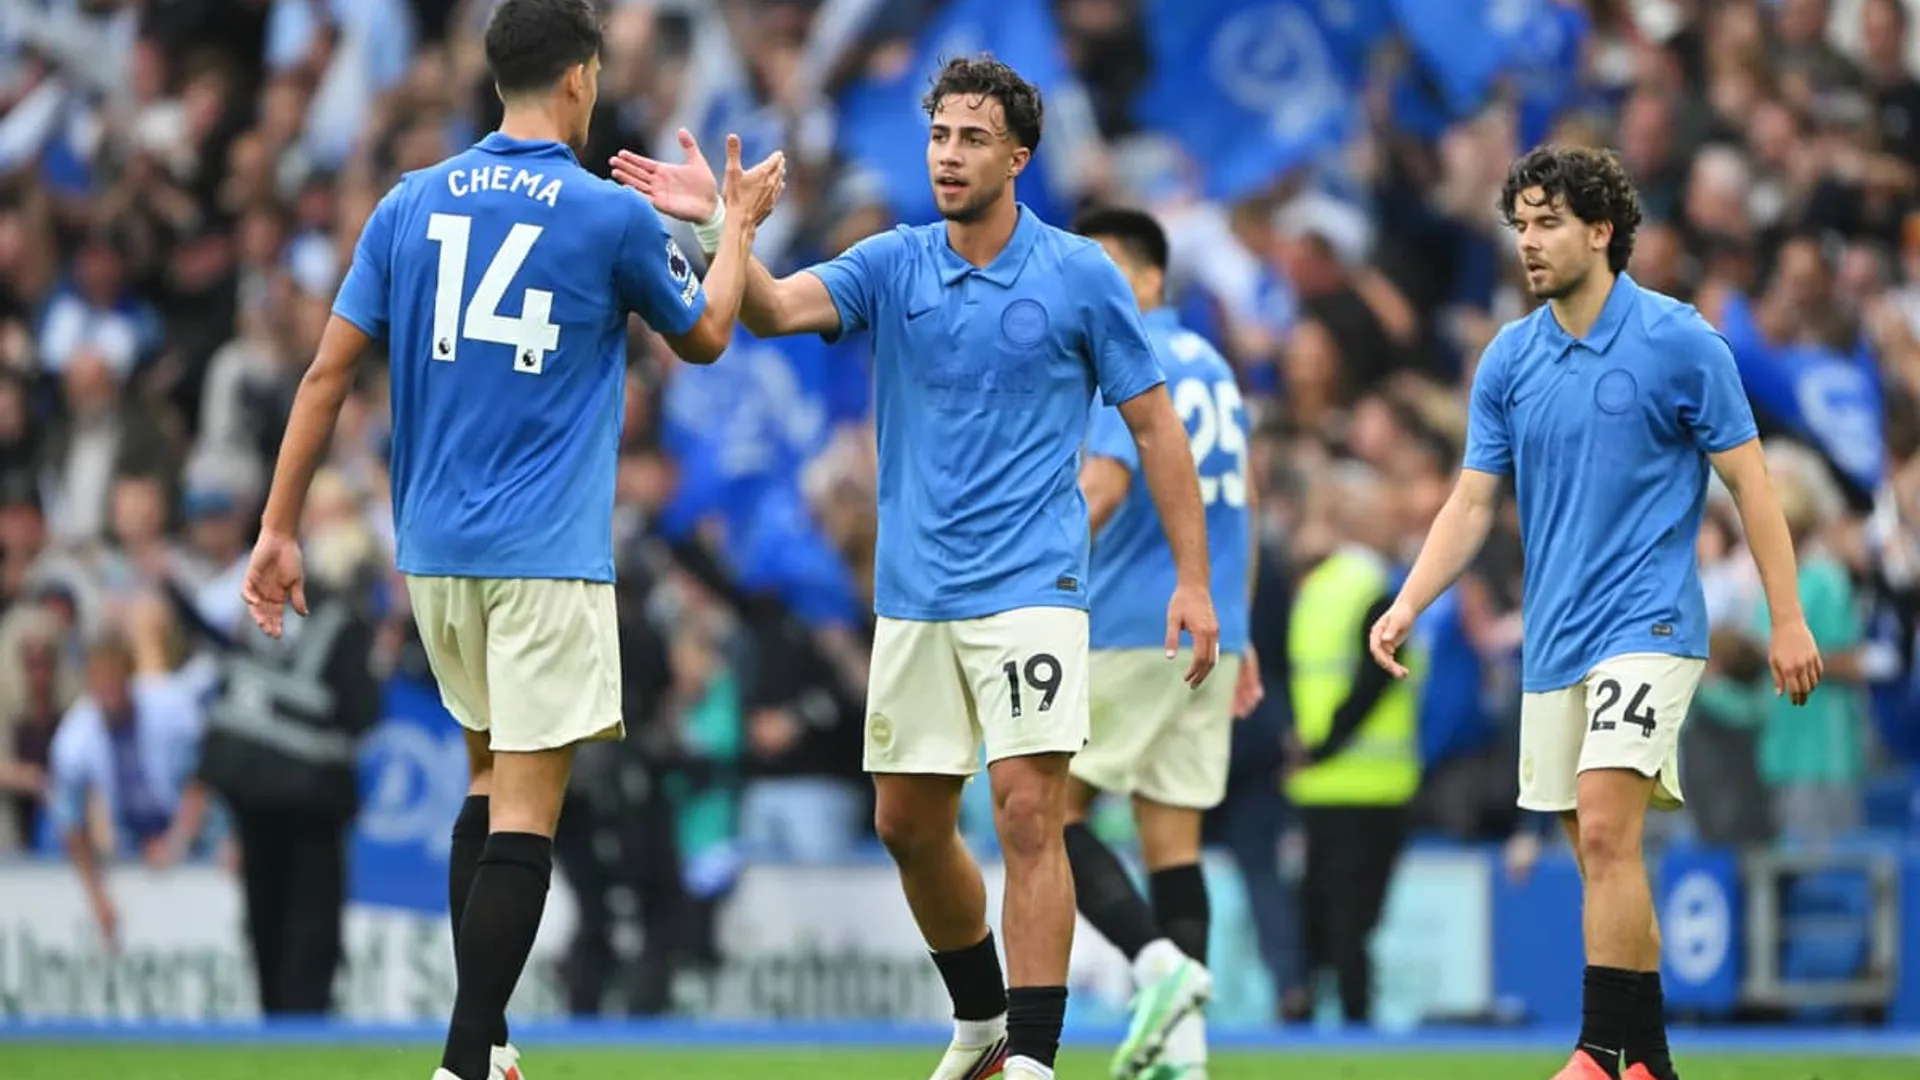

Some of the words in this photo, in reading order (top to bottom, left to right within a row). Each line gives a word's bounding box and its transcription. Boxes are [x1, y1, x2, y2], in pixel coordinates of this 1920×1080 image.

[447, 165, 563, 208] CHEMA
[426, 212, 560, 375] 14
[1173, 376, 1248, 508] 25
[1003, 652, 1062, 718] 19
[1590, 678, 1657, 739] 24
